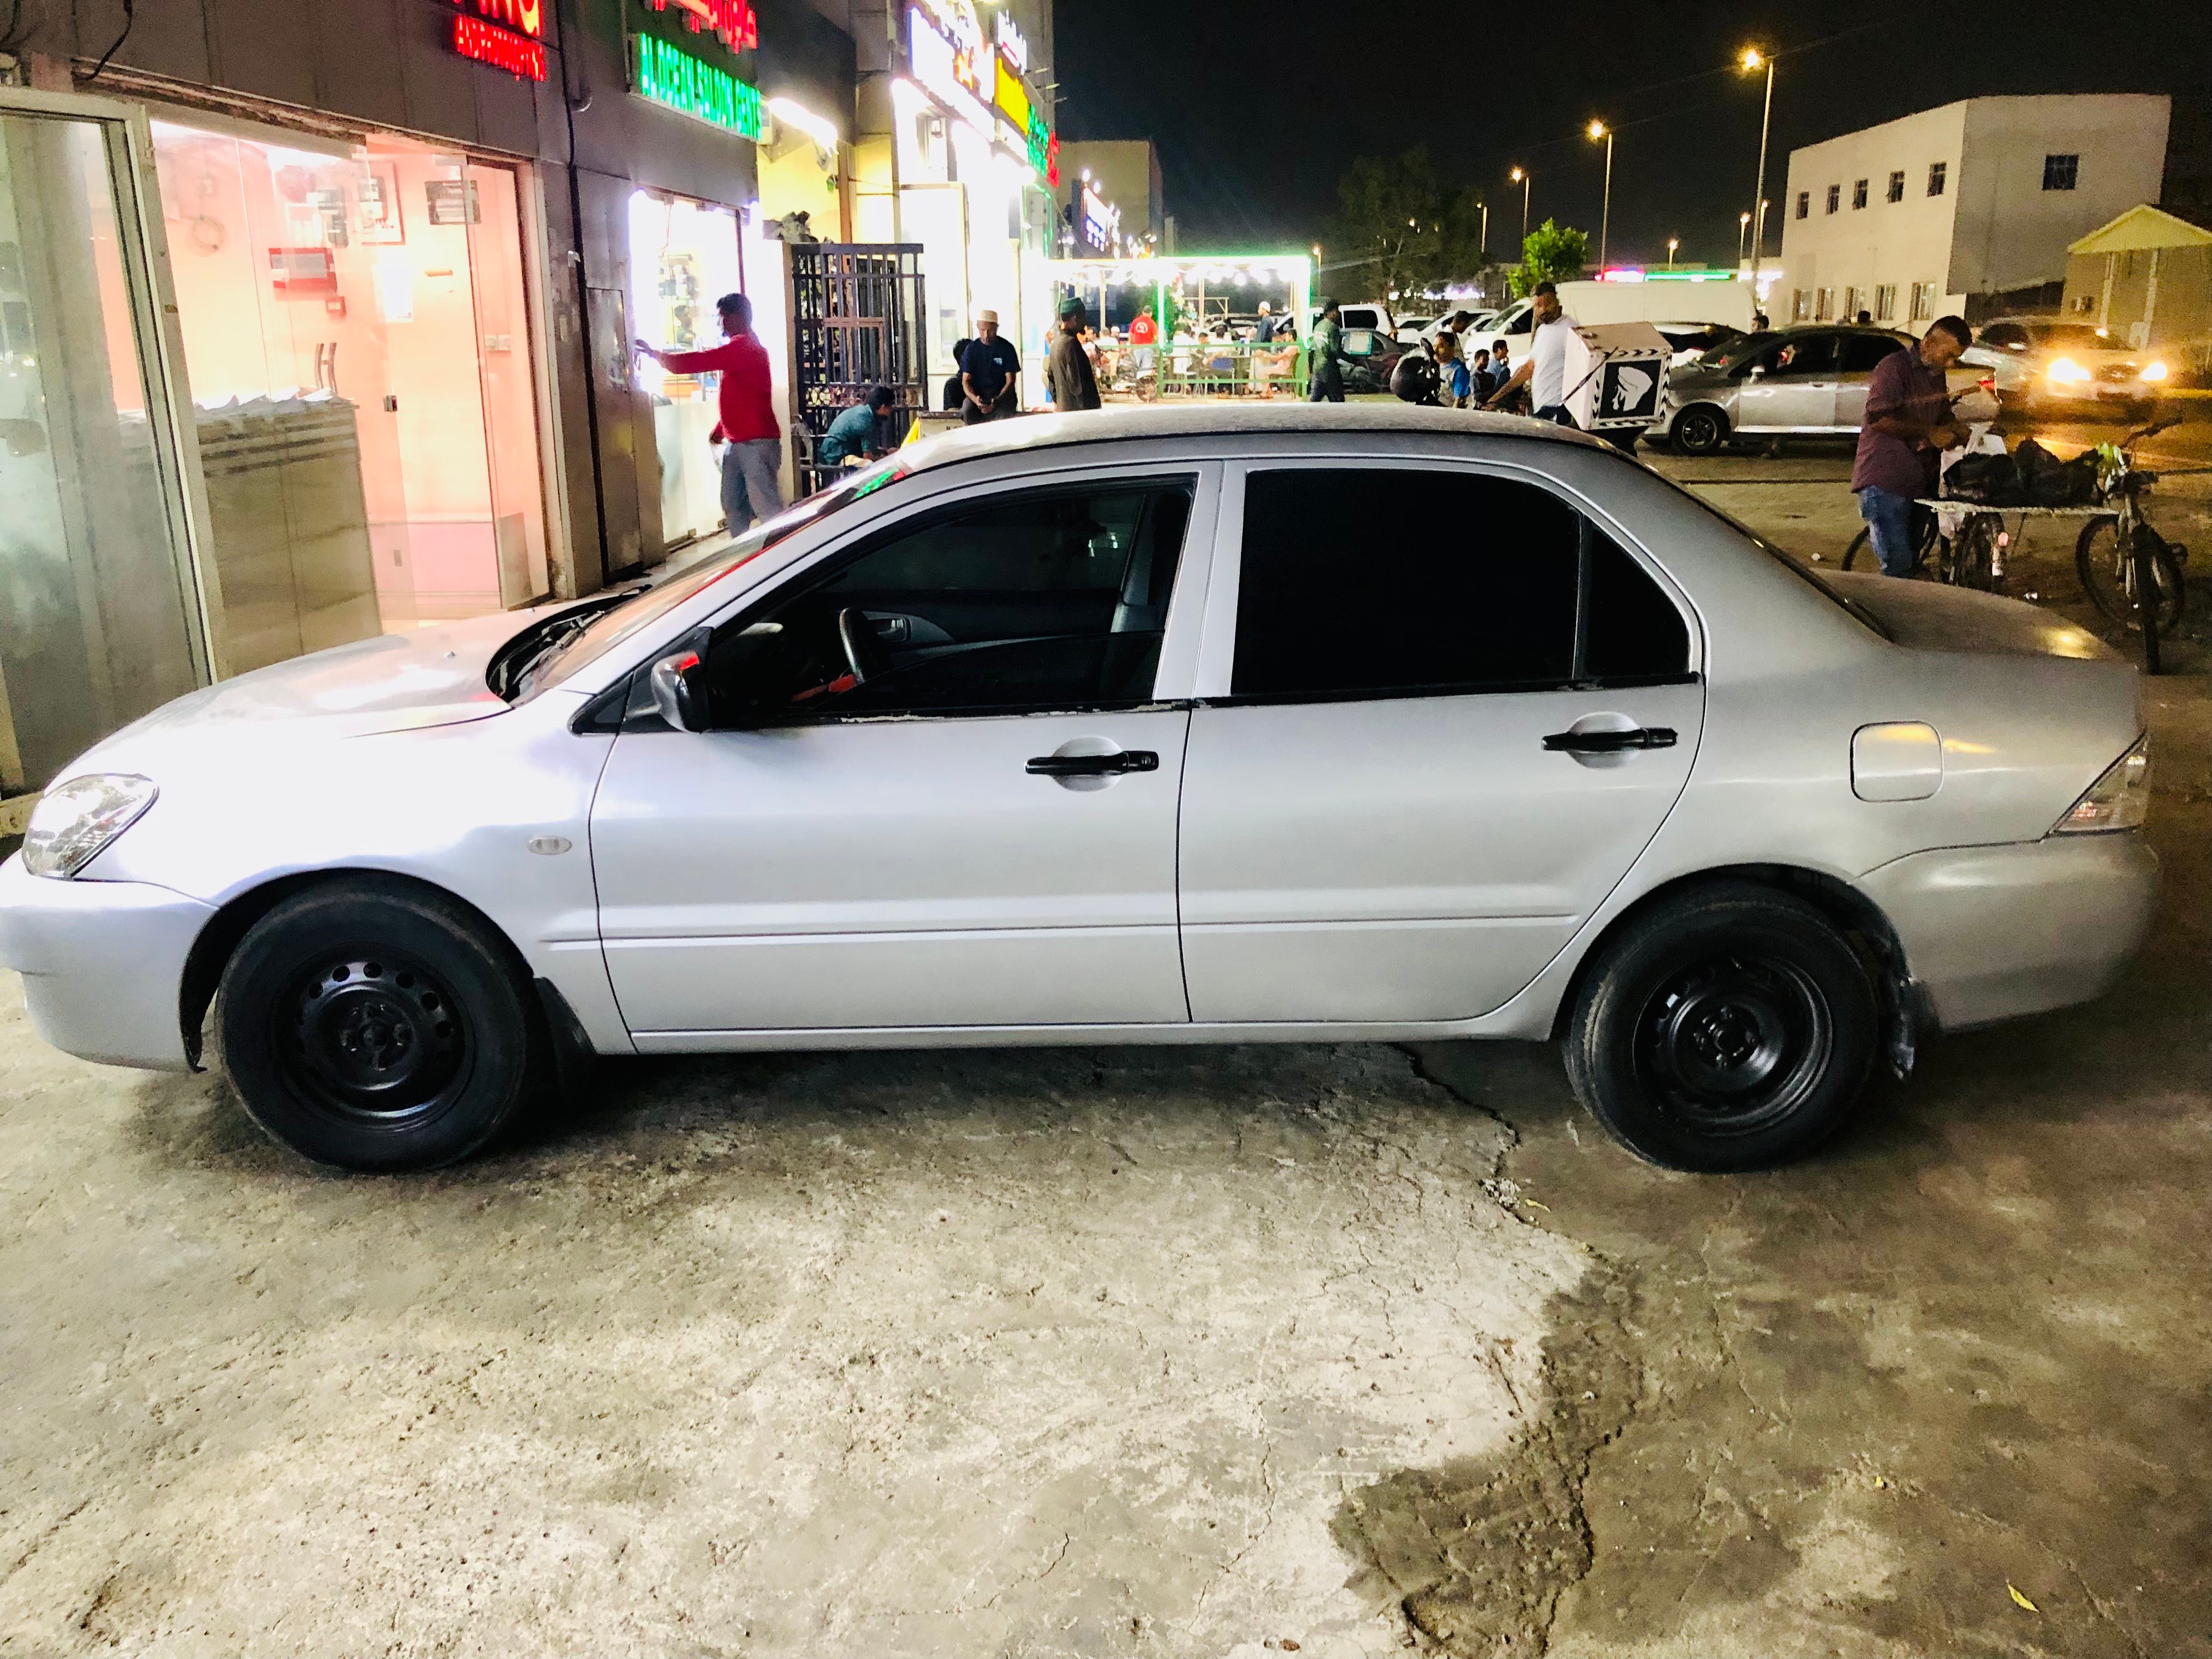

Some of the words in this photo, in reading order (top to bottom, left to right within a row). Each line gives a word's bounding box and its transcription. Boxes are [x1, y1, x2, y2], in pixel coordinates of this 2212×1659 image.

[641, 33, 657, 99] AL
[657, 39, 695, 112] OCEAN
[697, 59, 735, 129] SALOON
[735, 80, 762, 142] GENTS
